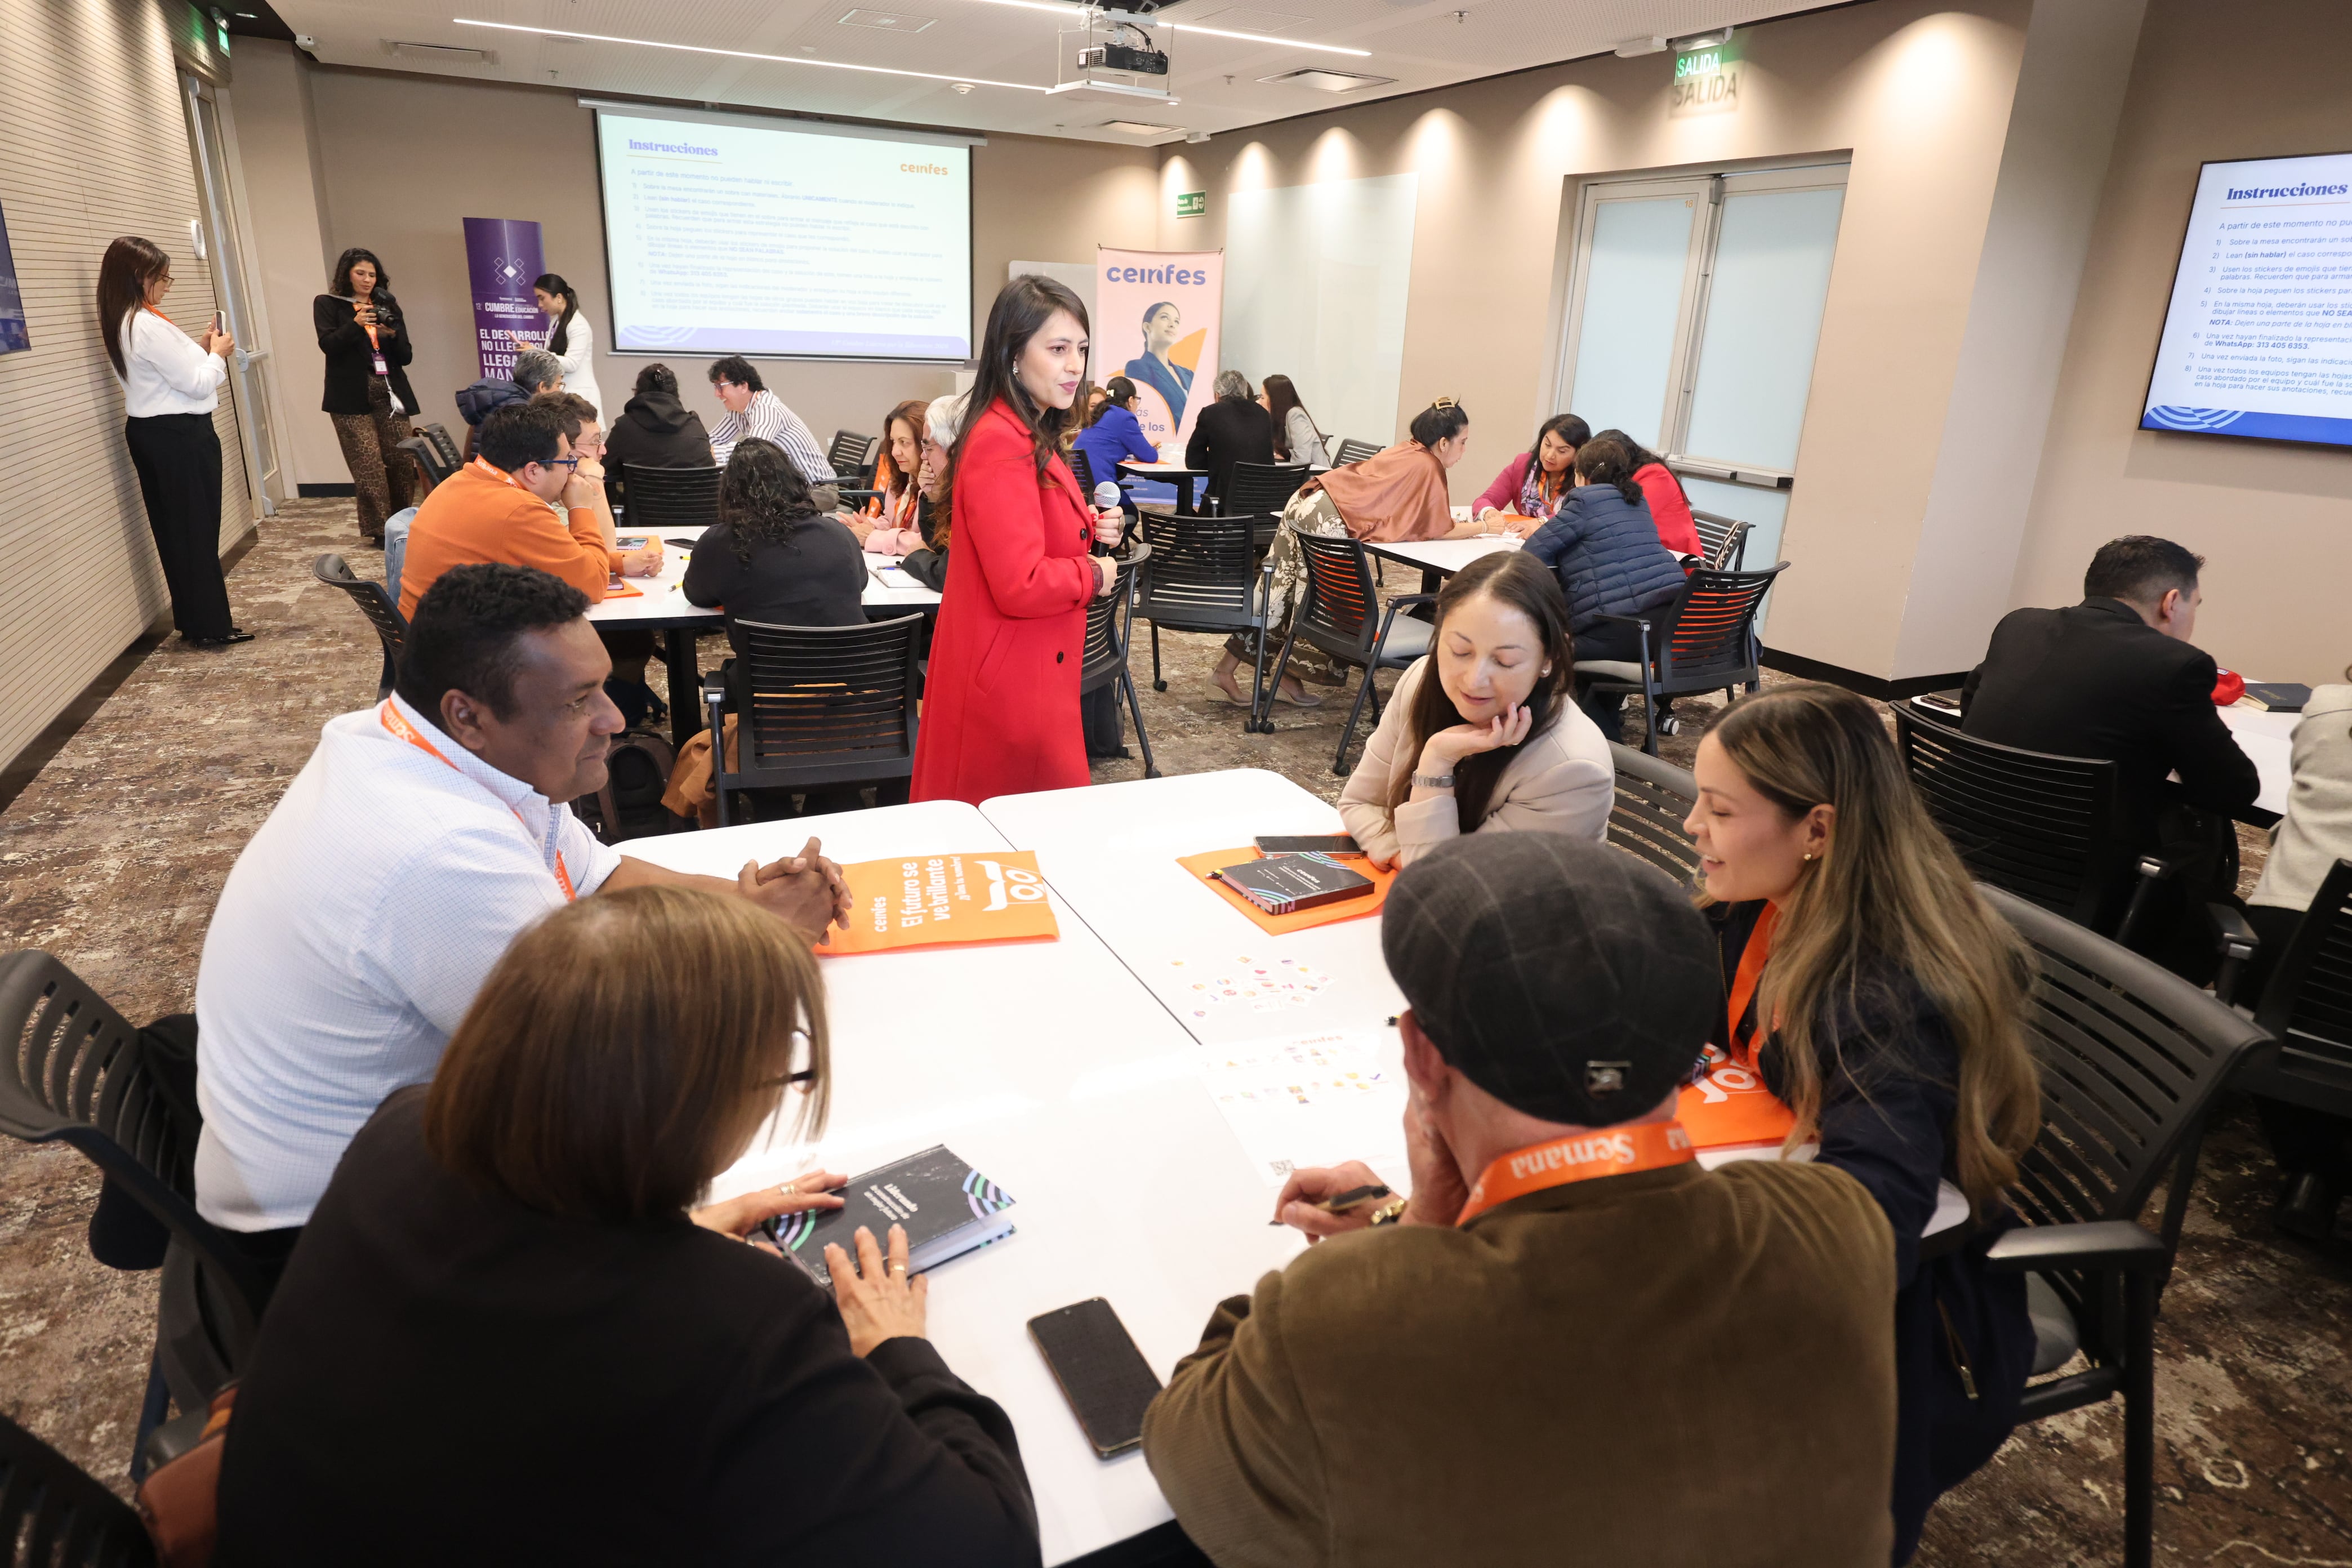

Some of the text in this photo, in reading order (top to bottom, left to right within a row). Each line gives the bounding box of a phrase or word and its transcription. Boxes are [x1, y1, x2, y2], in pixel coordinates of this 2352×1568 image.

[1677, 52, 1719, 77] SALIDA
[629, 139, 719, 157] Instrucciones
[900, 163, 948, 175] ceinfes
[2226, 182, 2348, 199] Instrucciones
[2227, 222, 2248, 231] partir
[1107, 264, 1206, 285] ceinfes
[485, 302, 515, 313] CUMBRE
[480, 329, 490, 339] EL
[482, 341, 493, 350] NO
[2282, 386, 2328, 395] anotaciones,
[1136, 407, 1148, 416] ás
[1149, 422, 1165, 431] los
[901, 862, 928, 928] El futuro se
[925, 858, 950, 921] ve brillante
[871, 897, 887, 932] ceinfes
[1509, 1133, 1635, 1179] Semana
